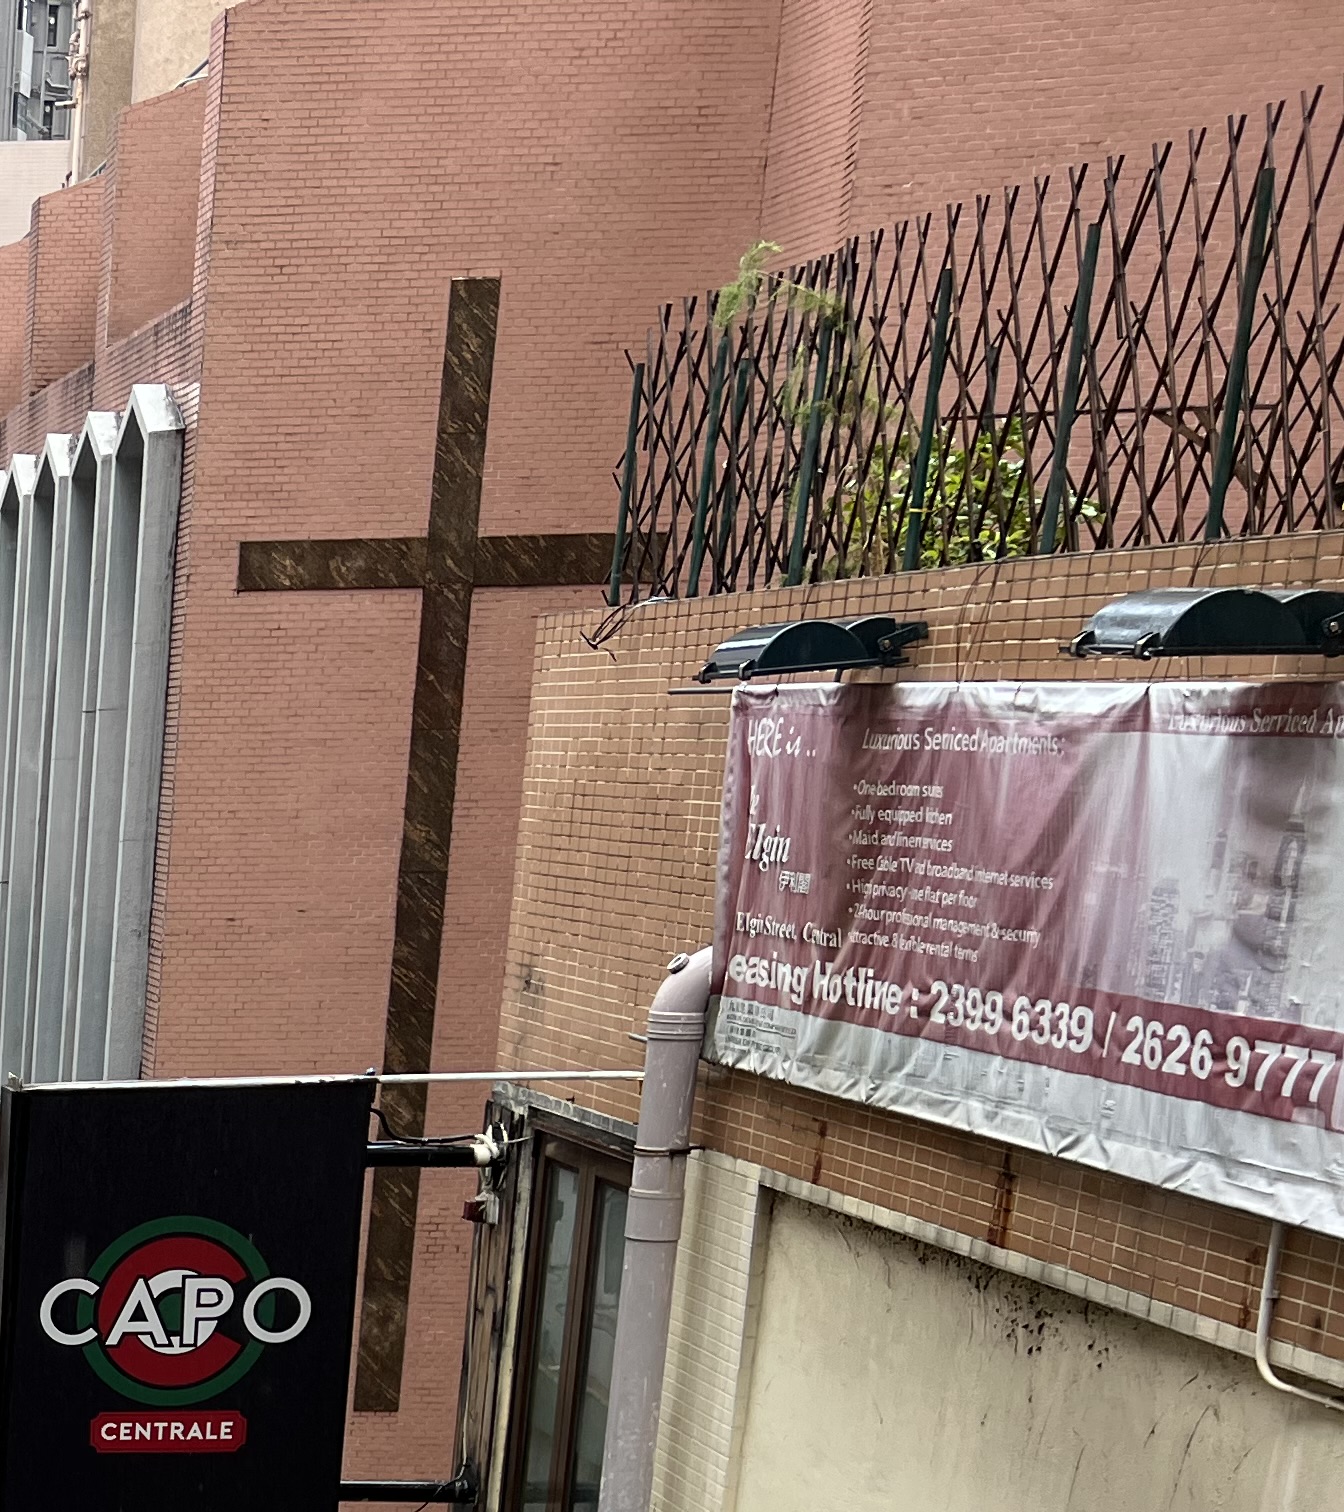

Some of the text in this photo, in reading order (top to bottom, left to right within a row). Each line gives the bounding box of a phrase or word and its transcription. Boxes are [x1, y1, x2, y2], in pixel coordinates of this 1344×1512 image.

[748, 717, 784, 758] HERE
[1249, 708, 1318, 733] Serviced
[853, 832, 878, 846] Maid
[852, 855, 874, 870] Free
[899, 858, 913, 873] TV
[914, 861, 926, 874] ad
[1010, 872, 1054, 890] services
[813, 960, 903, 1014] Hotline
[930, 980, 1003, 1034] 2399
[1012, 997, 1094, 1053] 6339
[1121, 1015, 1213, 1079] 2626
[1225, 1036, 1336, 1102] 9777
[40, 1277, 311, 1346] CAPO
[101, 1421, 233, 1441] CENTRALE
